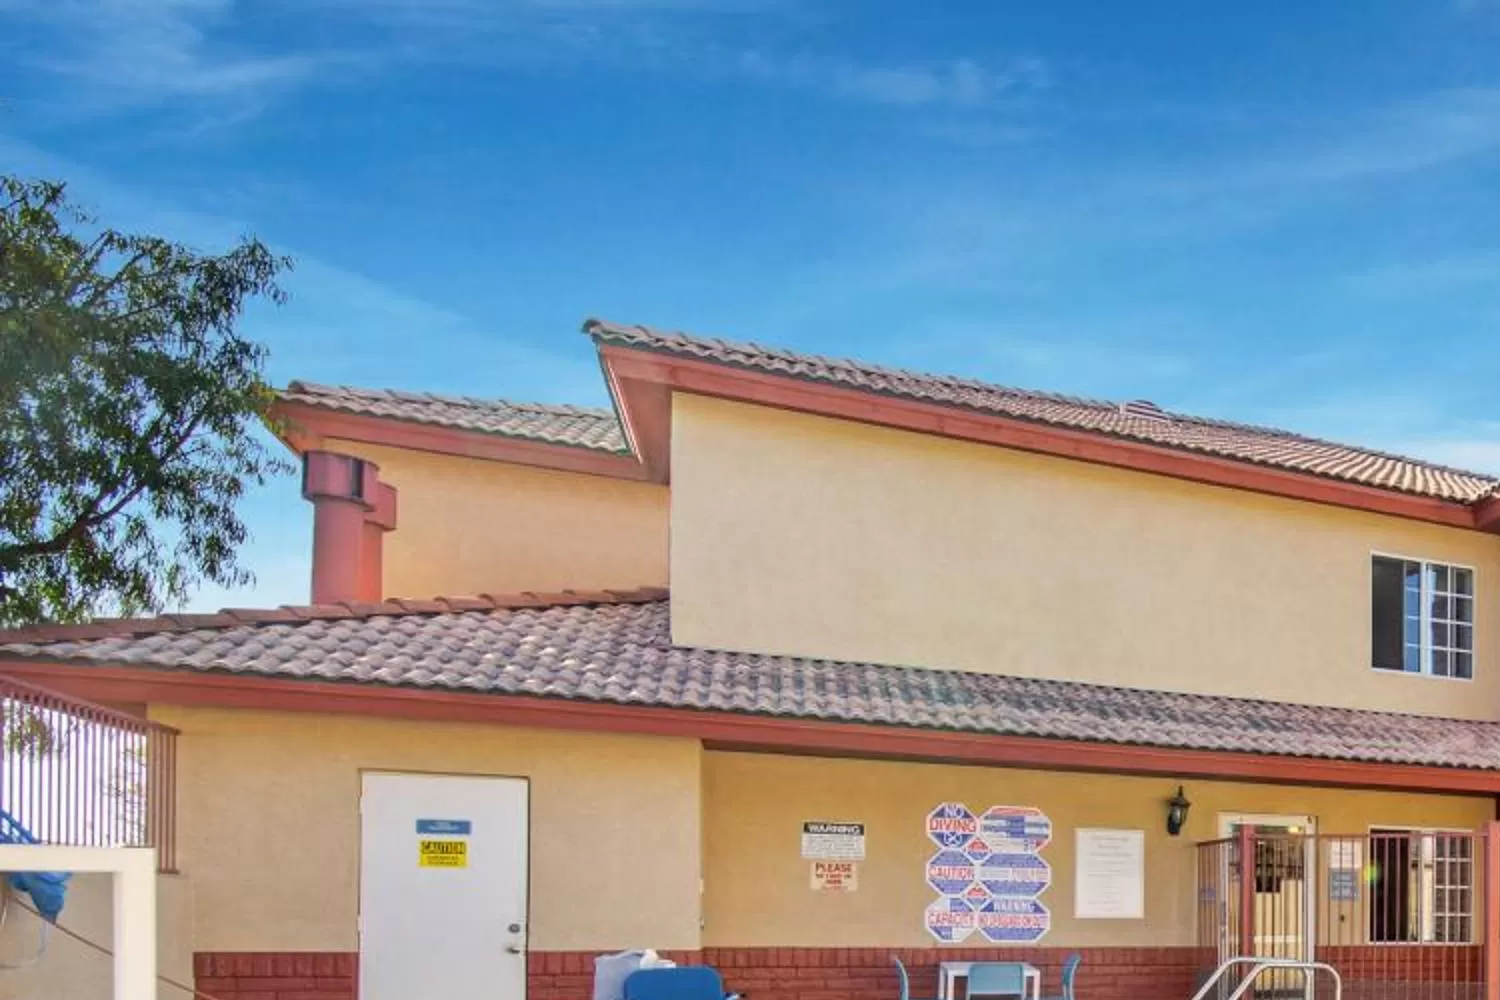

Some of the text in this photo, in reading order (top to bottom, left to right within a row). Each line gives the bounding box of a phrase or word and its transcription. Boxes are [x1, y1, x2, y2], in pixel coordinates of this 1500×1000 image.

[943, 803, 966, 817] NO
[807, 823, 861, 836] WARNING
[929, 818, 977, 833] DIVING
[420, 840, 466, 855] CAUTION
[815, 862, 852, 873] PLEASE
